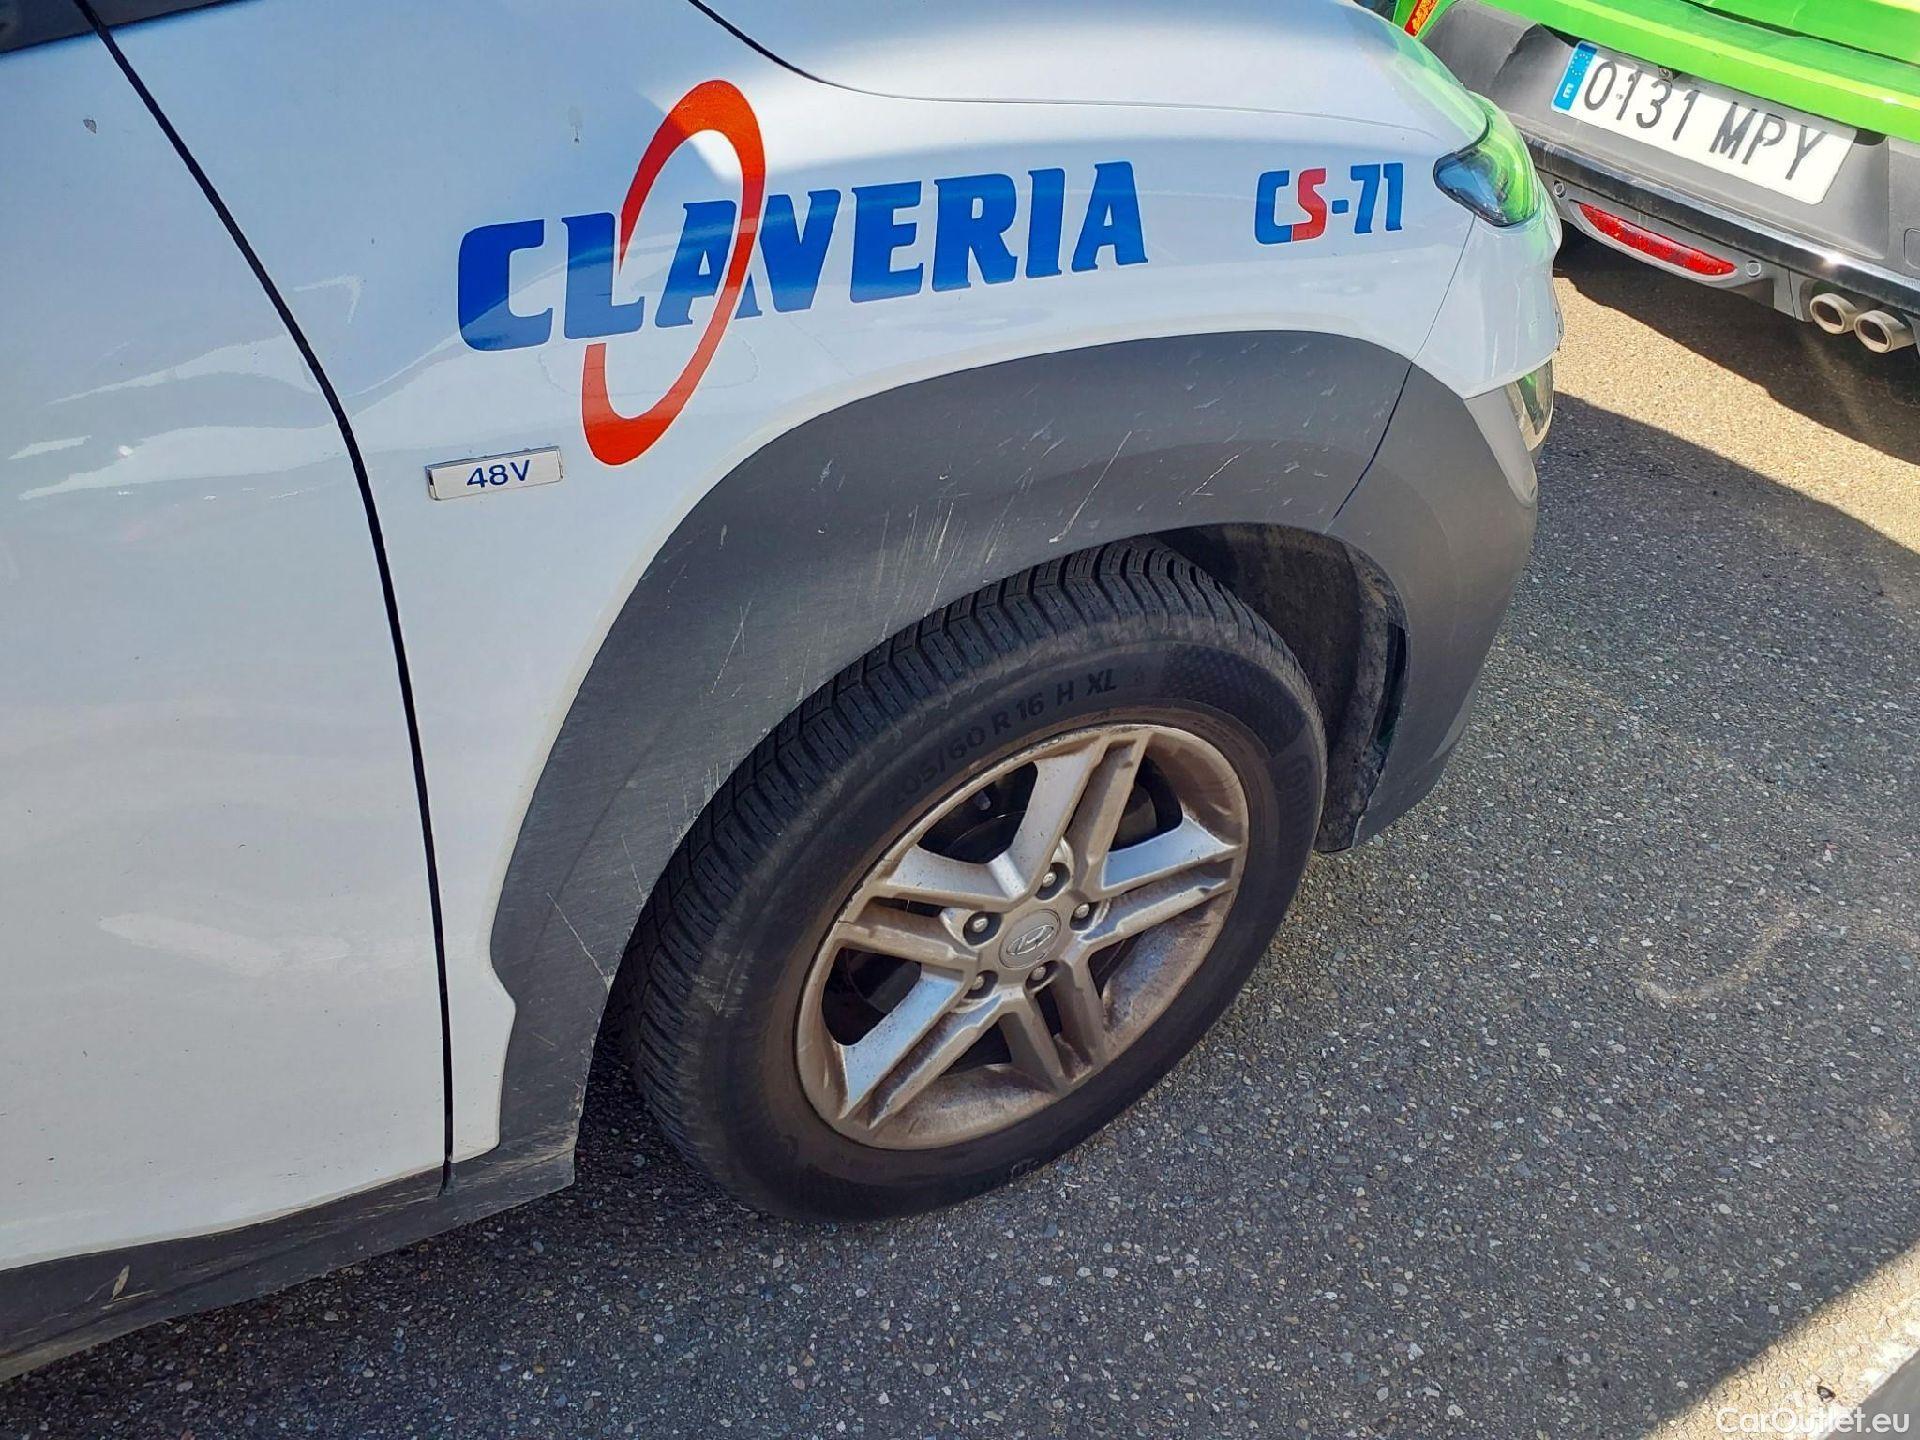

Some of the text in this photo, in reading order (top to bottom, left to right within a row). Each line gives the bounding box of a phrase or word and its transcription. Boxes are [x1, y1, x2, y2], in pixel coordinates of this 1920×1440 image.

[1584, 62, 1828, 181] 0131 MPY
[1254, 162, 1404, 245] CS-71
[457, 160, 1149, 352] CLAVERIA
[466, 459, 531, 489] 48V
[1015, 692, 1045, 721] 16
[1056, 680, 1075, 706] H
[1086, 668, 1118, 695] XL
